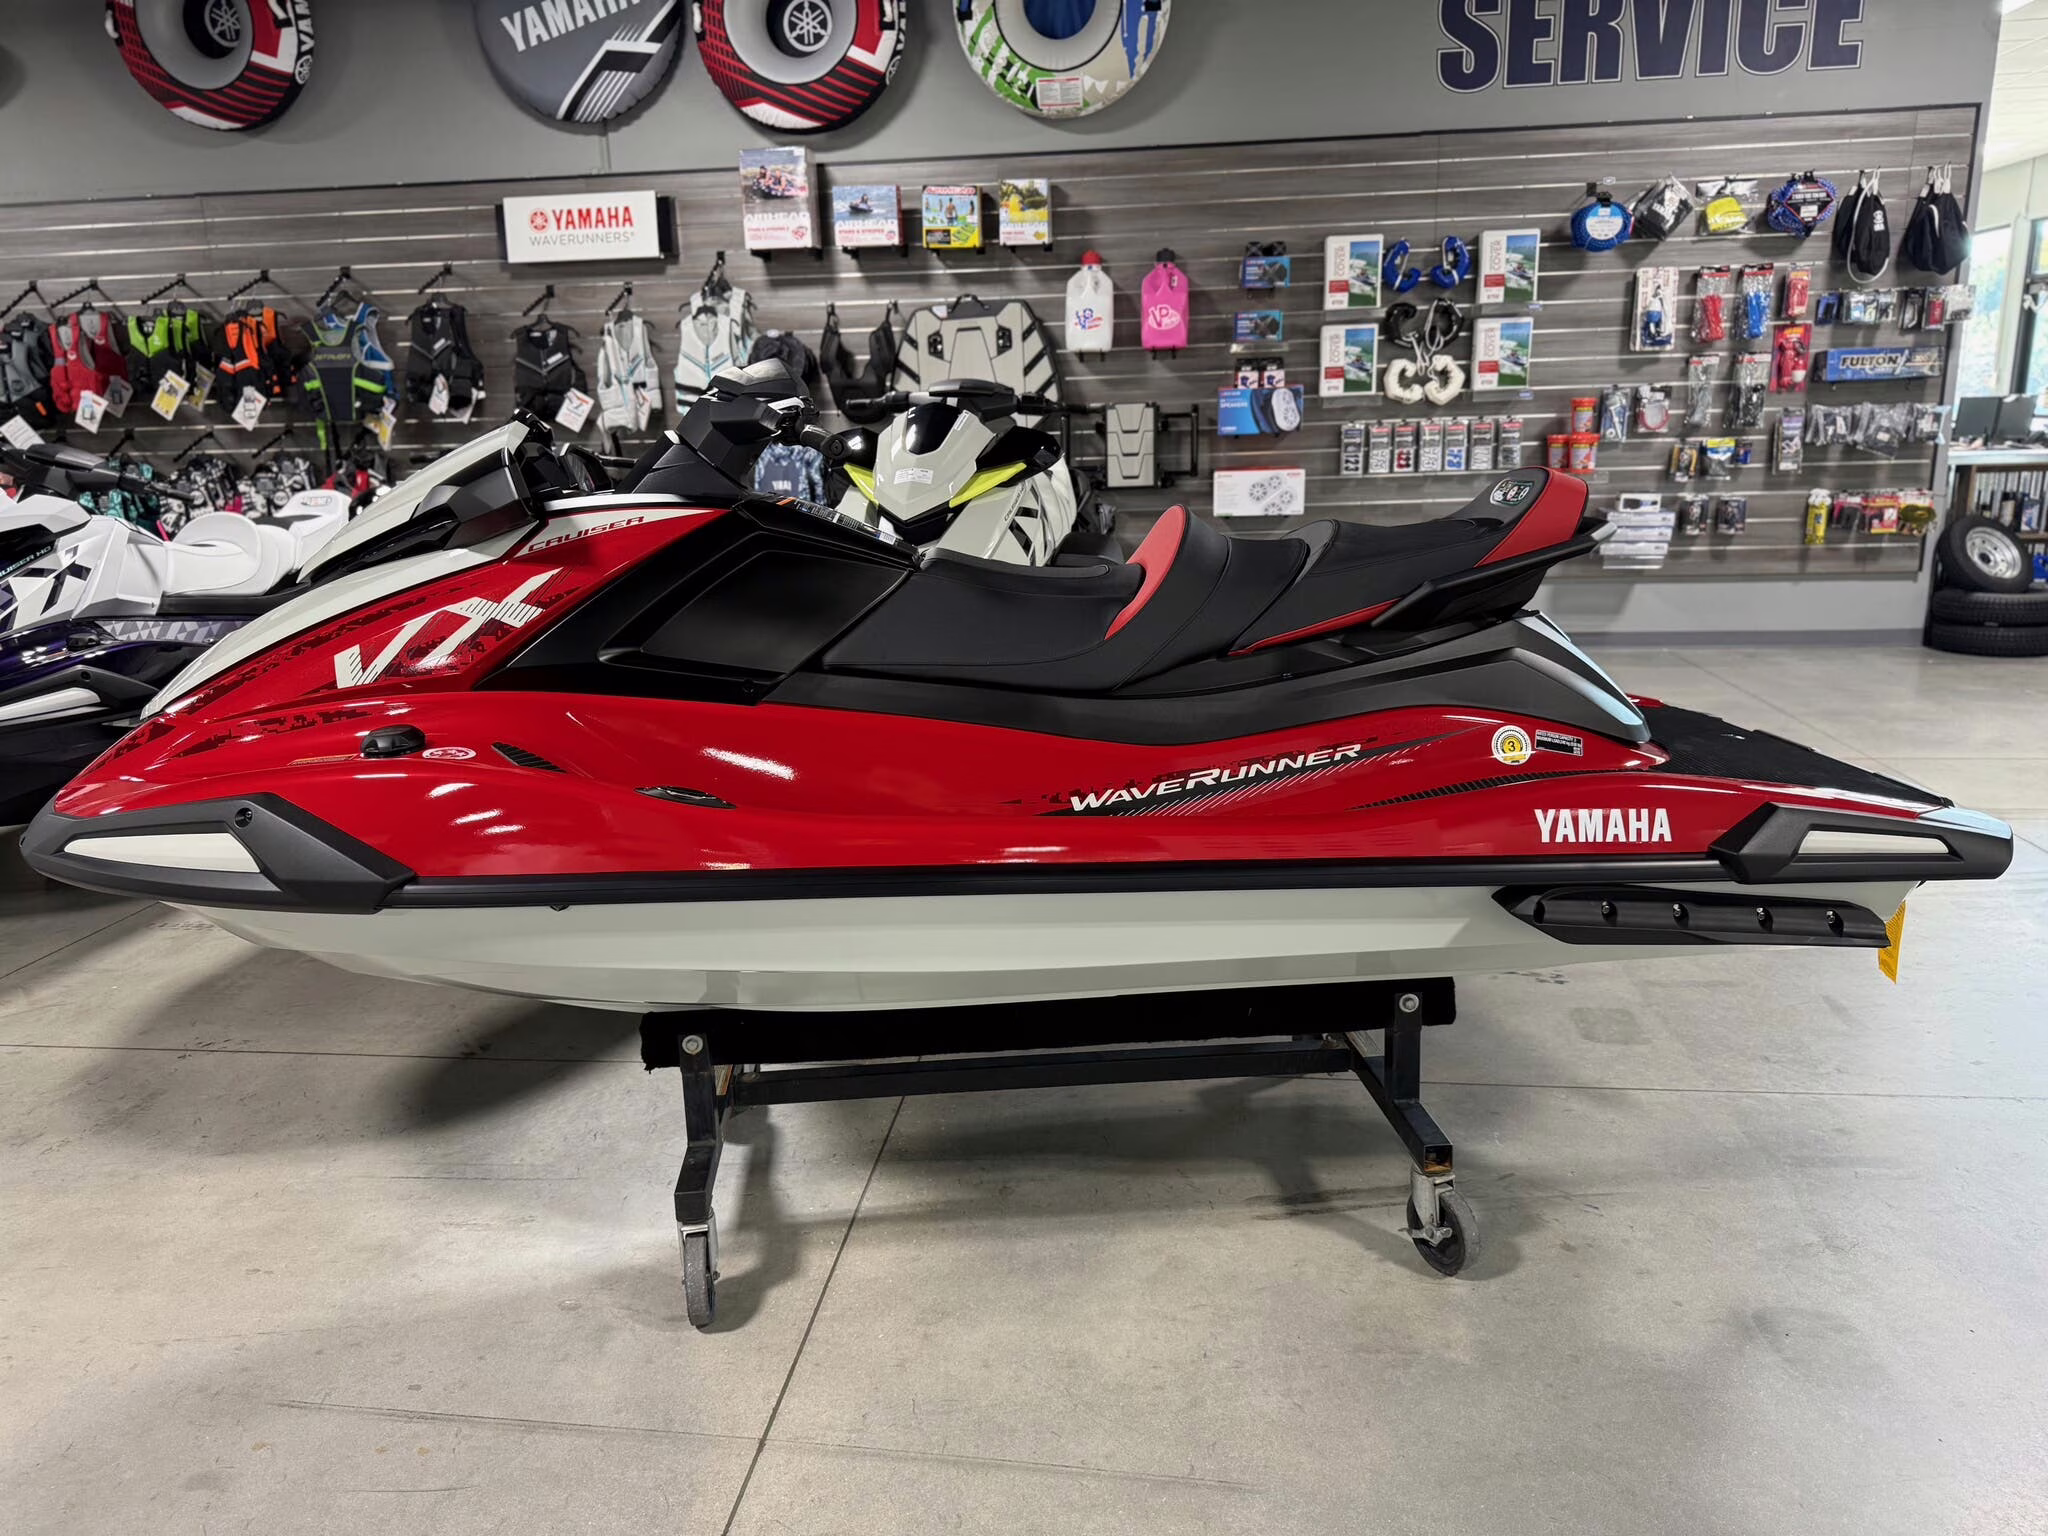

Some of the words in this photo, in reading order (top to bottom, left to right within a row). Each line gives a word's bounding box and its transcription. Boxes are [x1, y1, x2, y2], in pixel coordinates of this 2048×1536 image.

[501, 0, 641, 52] YAMA
[1437, 0, 1864, 93] SERVICE
[552, 205, 634, 231] YAMAHA
[1840, 355, 1899, 368] FULTON
[528, 515, 645, 553] CRUISER
[0, 554, 34, 577] UISER
[333, 566, 564, 690] VX
[1507, 740, 1516, 752] 3
[1069, 743, 1362, 812] WAVERUNNER
[1534, 808, 1673, 843] YAMAHA
